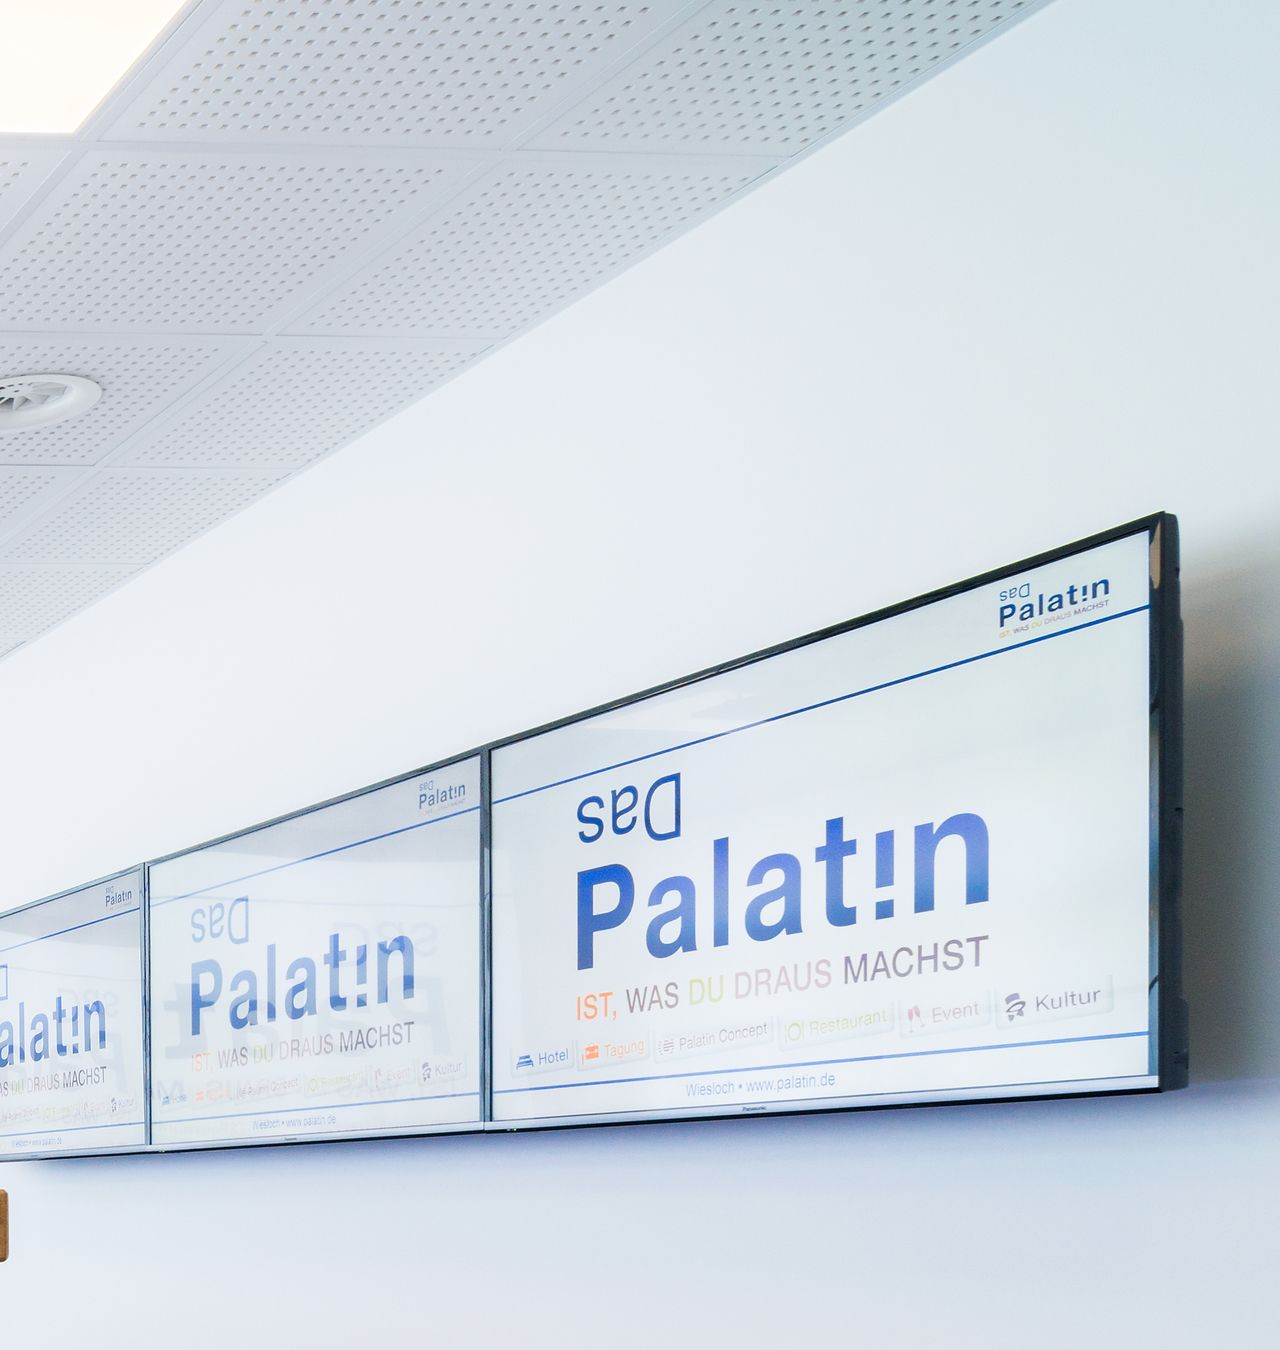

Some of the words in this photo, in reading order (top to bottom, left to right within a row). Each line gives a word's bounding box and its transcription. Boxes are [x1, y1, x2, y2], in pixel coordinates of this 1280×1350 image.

[1000, 583, 1030, 601] Das
[1073, 600, 1110, 616] MACHST
[576, 771, 682, 843] Das
[191, 895, 249, 944] Das
[576, 991, 618, 1021] IST,
[625, 982, 680, 1013] WAS
[689, 975, 725, 1006] DU
[735, 958, 833, 1000] DRAUS
[843, 935, 990, 984] MACHST
[932, 1001, 980, 1024] Event
[1034, 988, 1103, 1013] Kultur
[809, 1009, 889, 1035] Restaurant
[218, 1046, 249, 1069] WAS
[280, 1033, 334, 1060] DRAUS
[339, 1021, 415, 1052] MACHST
[604, 1039, 646, 1059] Tagung
[679, 1030, 717, 1051] Palatin
[720, 1021, 769, 1045] Concept
[538, 1048, 569, 1065] Hotel
[27, 1073, 60, 1093] DRAUS
[62, 1066, 108, 1089] MACHST
[685, 1074, 735, 1097] Wiesloch
[745, 1071, 837, 1095] www.palatin.de
